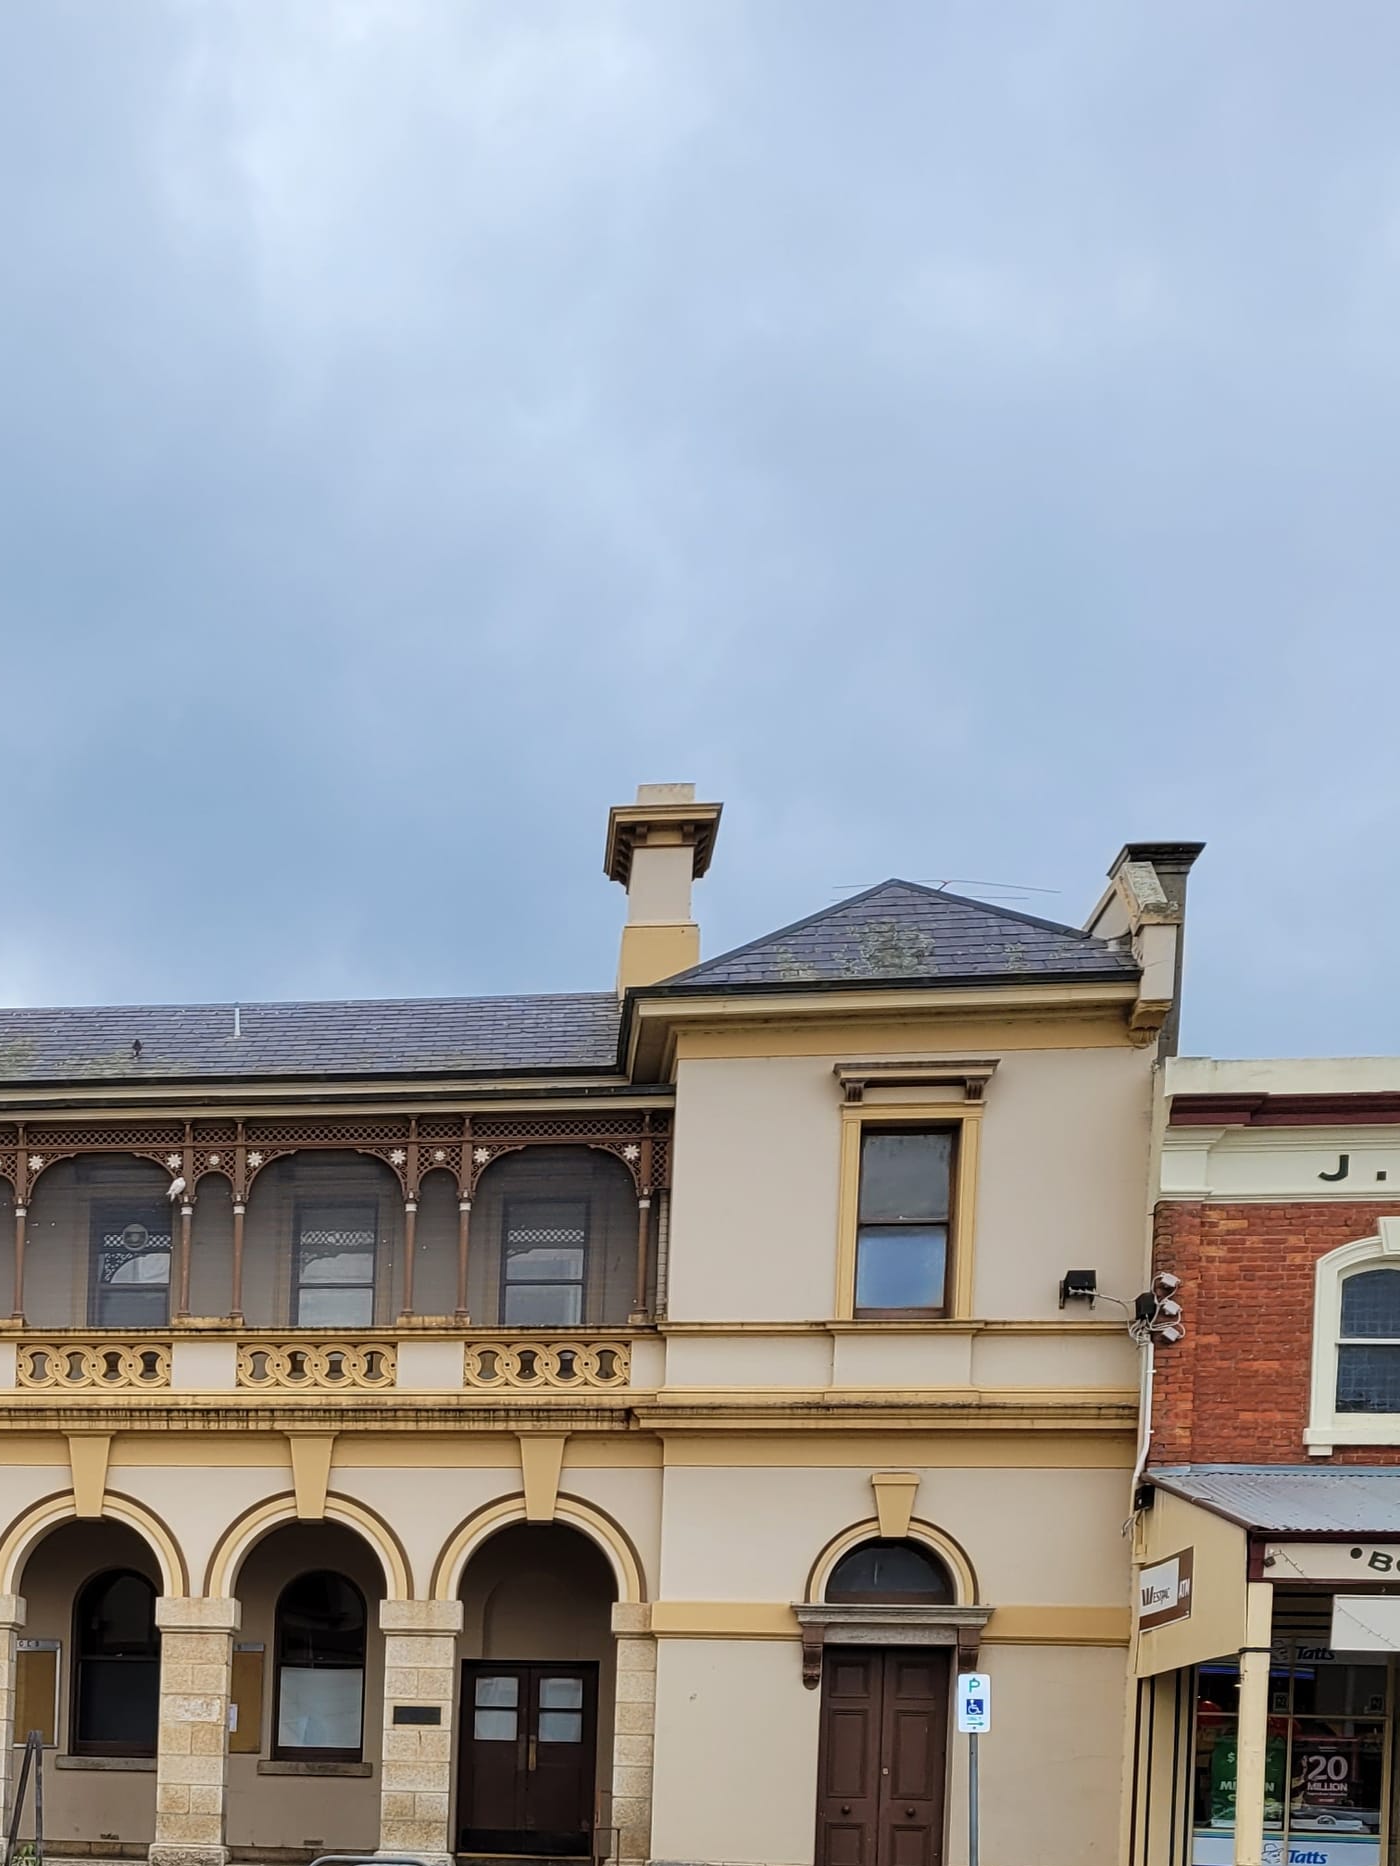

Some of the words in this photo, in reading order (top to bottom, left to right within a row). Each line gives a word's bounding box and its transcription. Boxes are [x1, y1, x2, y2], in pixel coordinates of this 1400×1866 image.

[1367, 1550, 1400, 1572] B
[1295, 1645, 1336, 1661] Tatts
[968, 1679, 981, 1693] P
[1307, 1781, 1349, 1792] MILLION
[1287, 1849, 1329, 1865] Tatts
